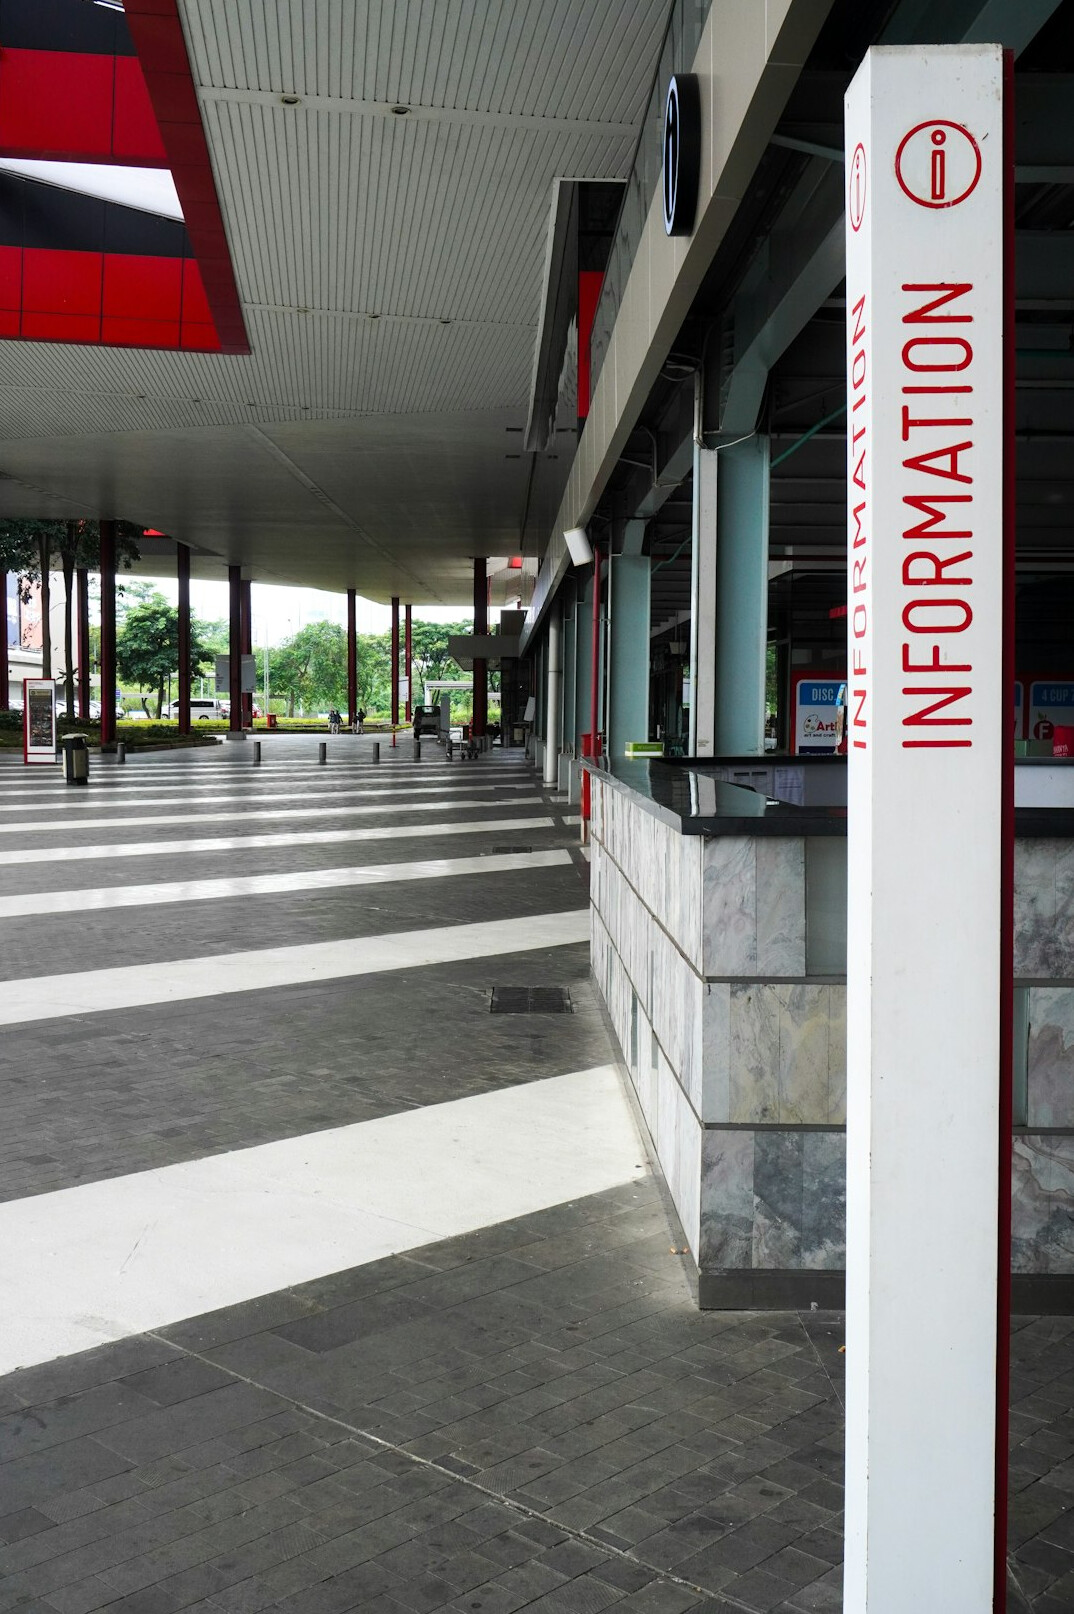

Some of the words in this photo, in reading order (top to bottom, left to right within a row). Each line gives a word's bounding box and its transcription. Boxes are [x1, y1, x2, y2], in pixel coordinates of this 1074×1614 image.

[852, 294, 867, 749] INFORMATION
[902, 283, 973, 748] INFORMATION
[1050, 688, 1069, 702] CUP
